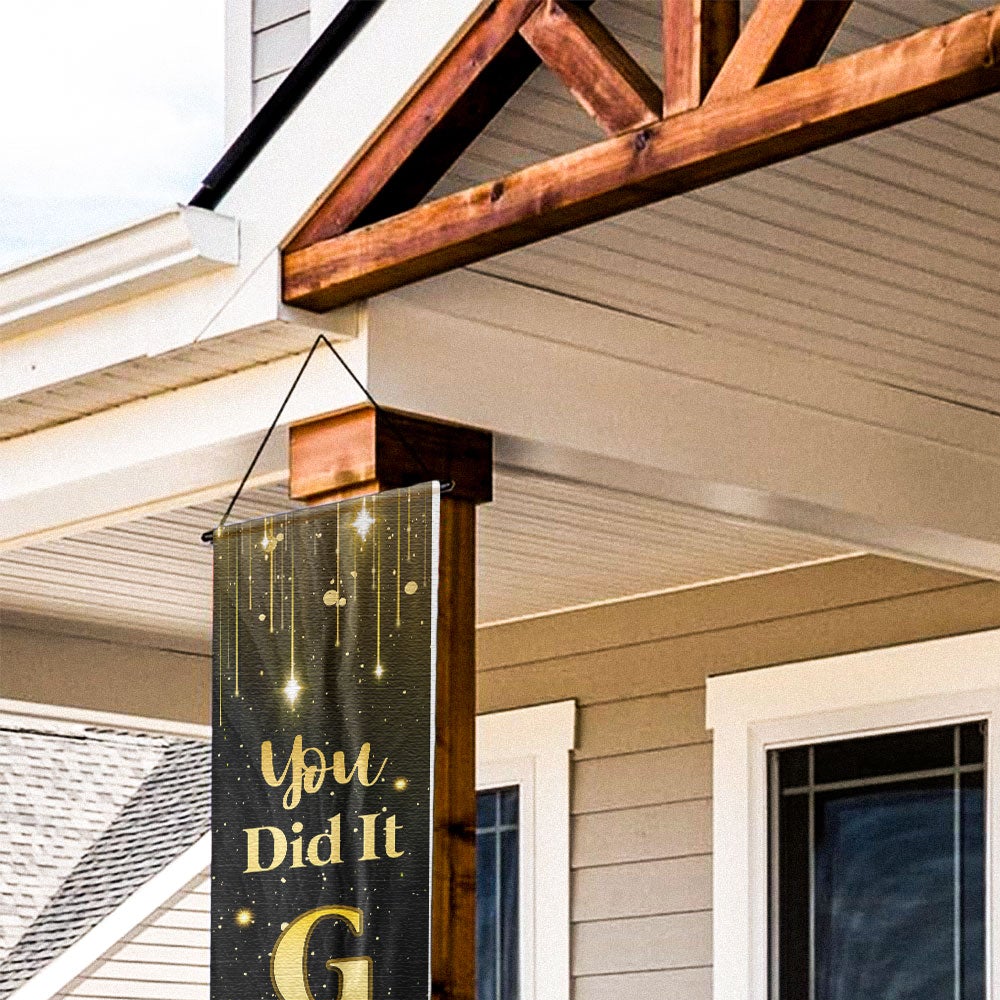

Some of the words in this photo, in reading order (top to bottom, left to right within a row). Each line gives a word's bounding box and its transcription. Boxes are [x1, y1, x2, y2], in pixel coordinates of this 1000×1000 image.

[260, 734, 388, 810] You
[242, 812, 344, 874] Did
[357, 812, 405, 862] It
